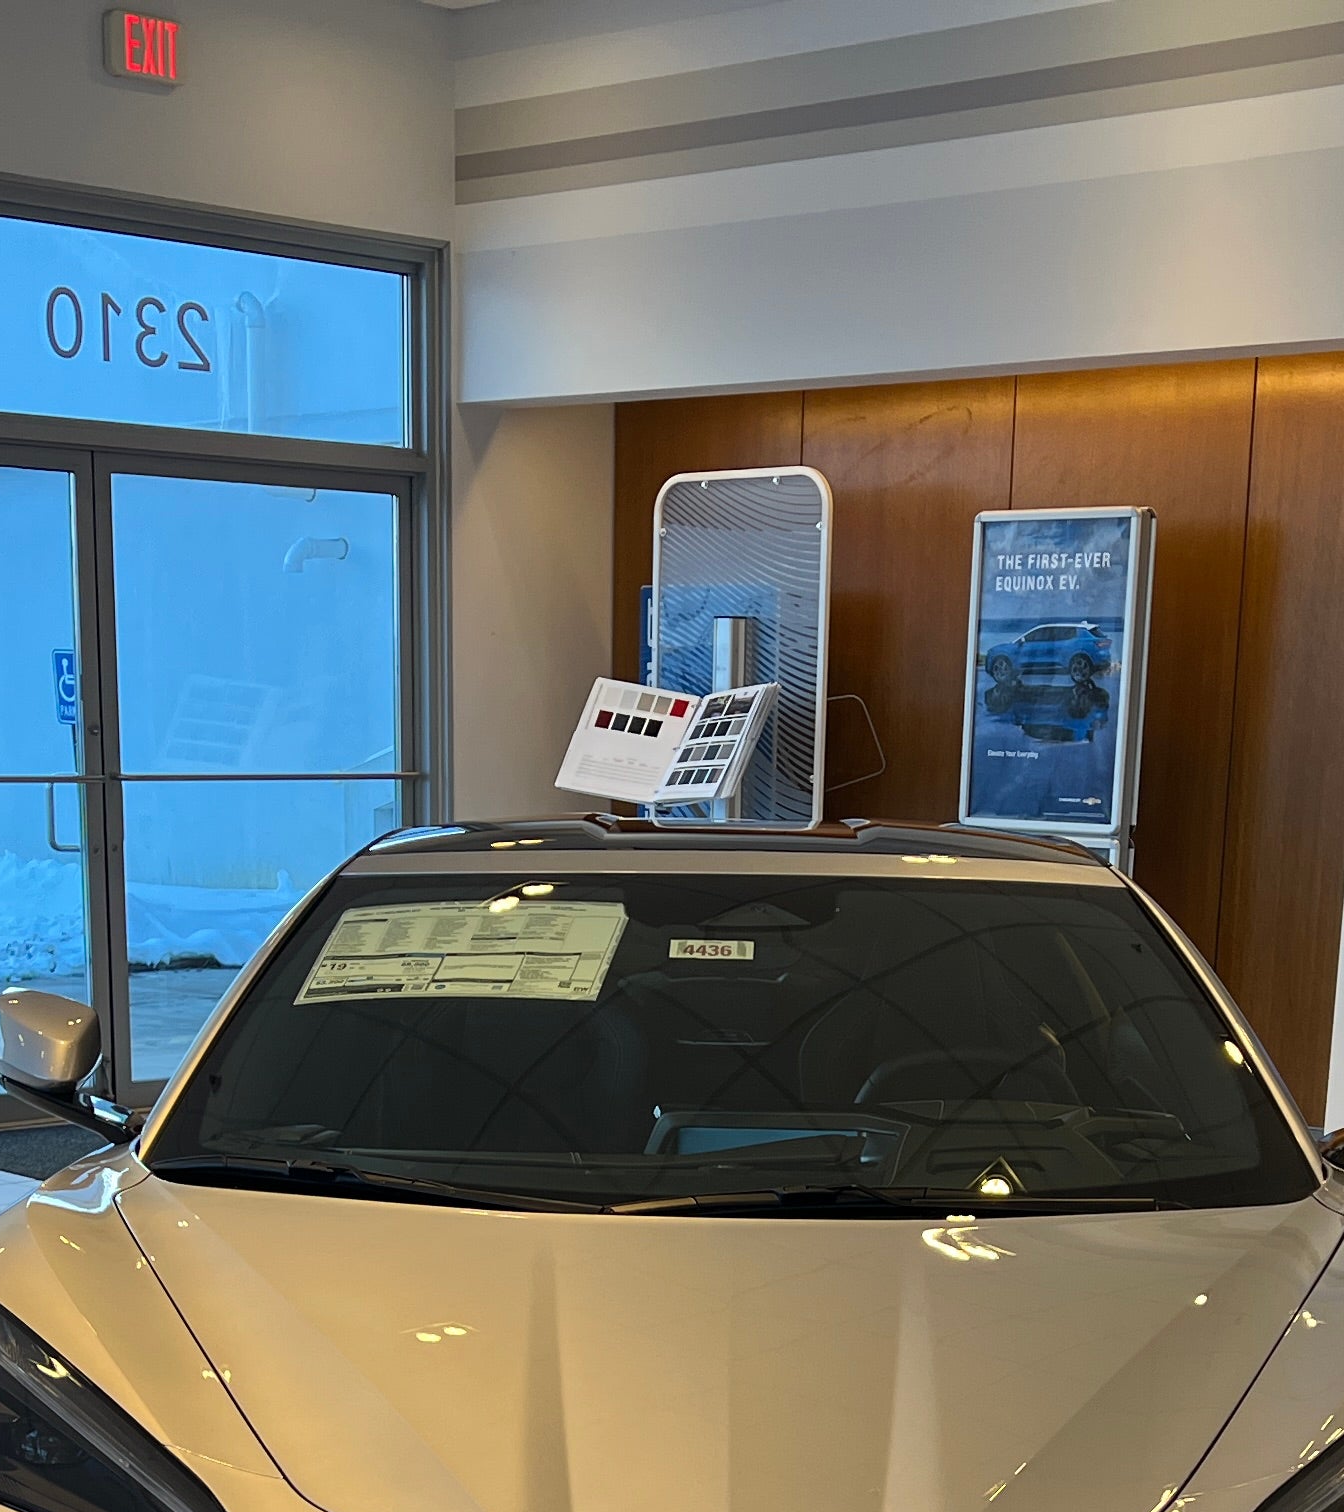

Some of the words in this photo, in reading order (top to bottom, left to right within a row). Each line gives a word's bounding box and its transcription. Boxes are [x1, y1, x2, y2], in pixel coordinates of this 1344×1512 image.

[124, 13, 179, 80] EXIT
[997, 554, 1023, 570] THE
[1027, 552, 1112, 570] FIRST-EVER
[996, 575, 1054, 592] EQUINOX
[1059, 575, 1080, 590] EV.
[684, 944, 733, 957] 4436
